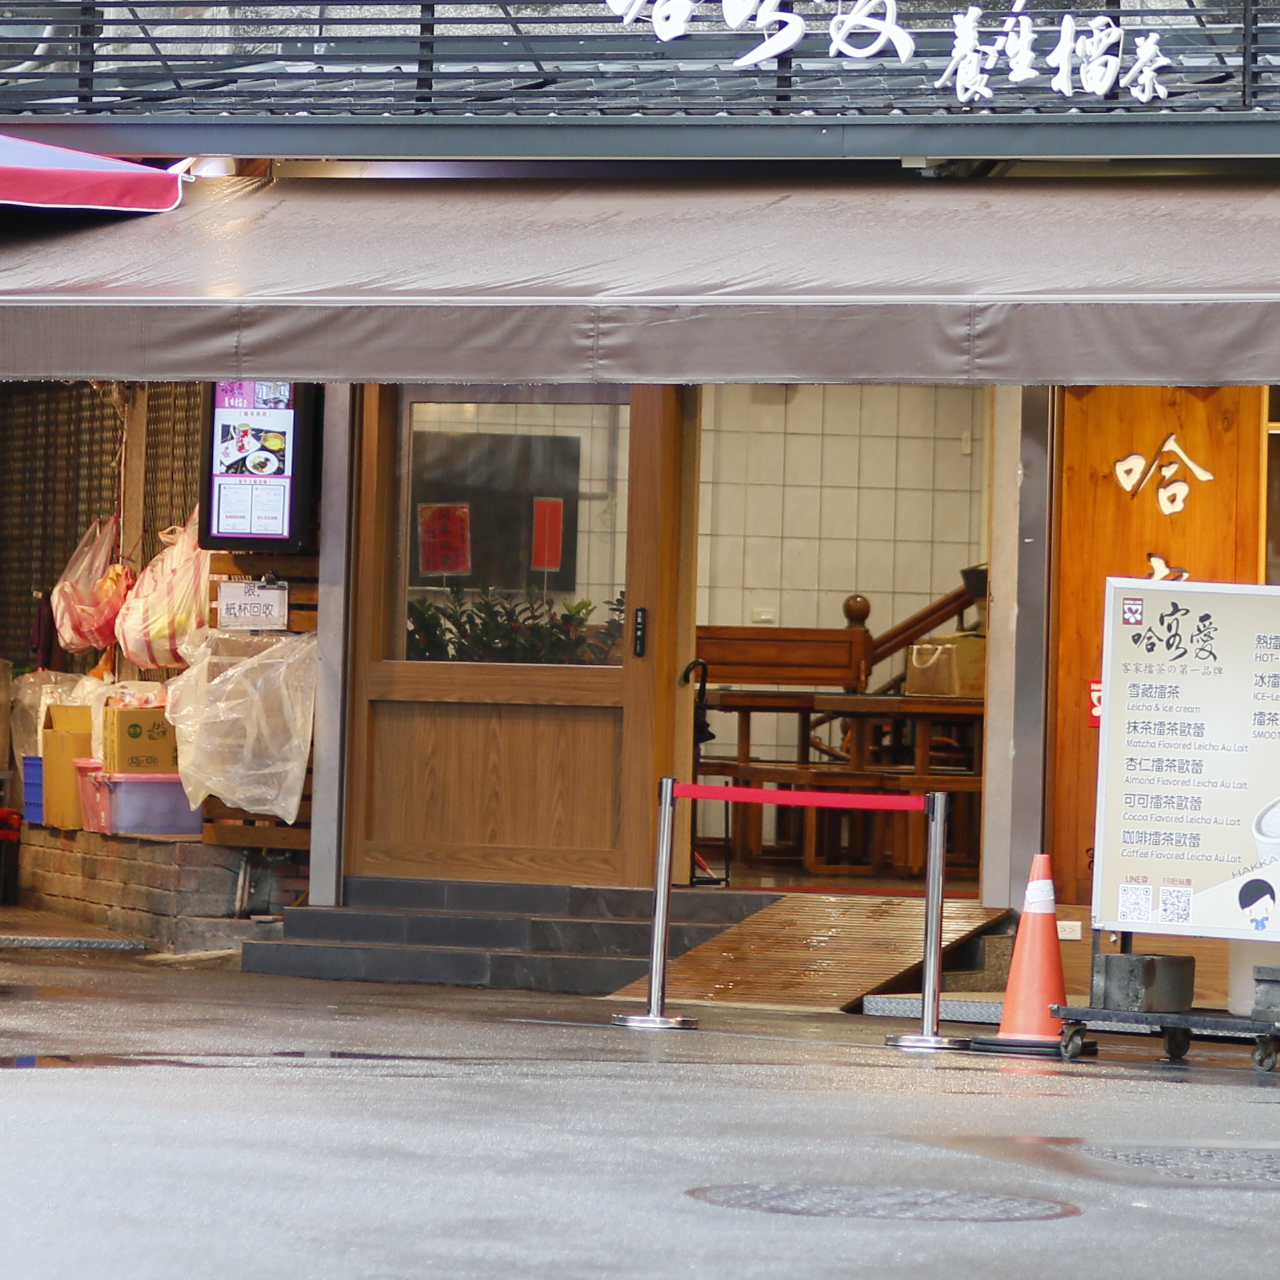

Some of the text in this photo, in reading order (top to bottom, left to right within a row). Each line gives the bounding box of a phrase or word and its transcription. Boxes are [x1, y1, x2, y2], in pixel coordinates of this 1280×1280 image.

[933, 6, 1172, 104] 養生擂茶
[1131, 601, 1218, 662] 哈客愛
[1127, 702, 1152, 712] Leicha
[1154, 703, 1160, 712] &
[1126, 739, 1249, 753] Matcha Flavored Leicha Au Lait
[1124, 775, 1248, 790] Almond Flavored Leicha Au Lait
[1122, 812, 1241, 826] Cocoa Flavored Leicha Au Lait
[1120, 849, 1242, 863] Coffee Flavored Leicha Au Lait
[1231, 855, 1279, 879] HAKKA
